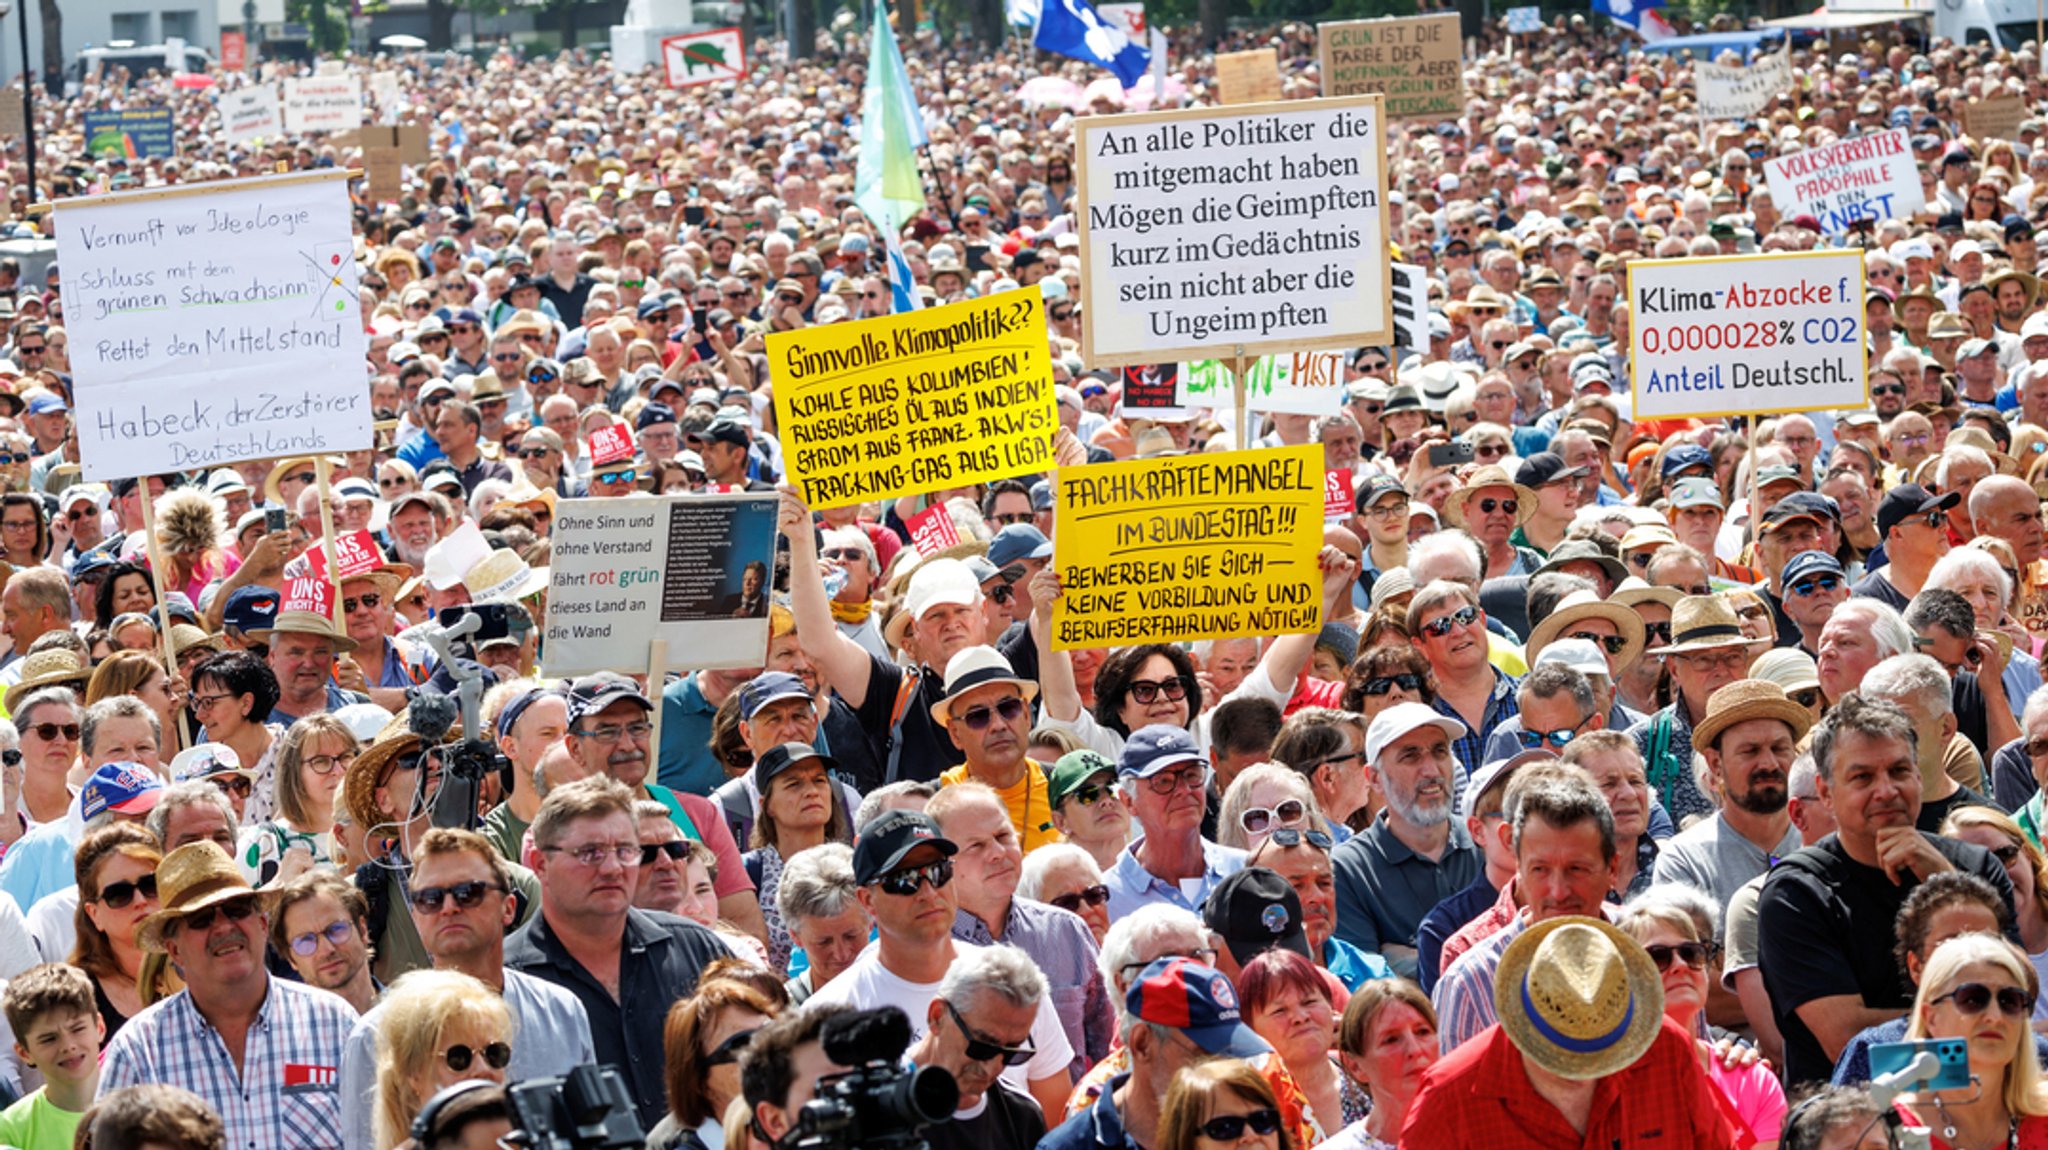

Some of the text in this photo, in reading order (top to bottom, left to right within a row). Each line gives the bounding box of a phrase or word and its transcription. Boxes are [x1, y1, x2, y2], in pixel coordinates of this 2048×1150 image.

[1379, 27, 1406, 43] IST
[1416, 24, 1443, 42] DIE
[1332, 46, 1424, 64] FARBE DER
[1417, 61, 1457, 76] ABER
[1334, 82, 1386, 96] DIESES
[1438, 77, 1457, 91] IST
[1098, 112, 1368, 157] An alle Politiker die
[1114, 152, 1359, 193] mitgemacht haben
[1090, 185, 1378, 233] Mögen die Geimpften
[1810, 190, 1867, 214] IN DEN
[1819, 193, 1895, 235] KNAST
[80, 204, 311, 251] Vernunft vor Ideologie
[1111, 225, 1361, 268] kurz im Gedächtnis
[79, 264, 236, 290] Schluss mit dem
[1119, 264, 1355, 303] sein nicht aber die
[1640, 277, 1851, 314] Klima-Abzocke f.
[95, 278, 308, 320] grünen Schwachsinn
[786, 299, 1033, 380] Sinnvolle Klimapolitik??
[1149, 302, 1329, 340] Ungeimpften
[1642, 317, 1858, 355] 0,000028% CO2
[96, 323, 341, 362] Rettet den Mittelstand
[1647, 357, 1854, 393] Anteil Deutschl.
[97, 391, 360, 440] Habeck, der Zerstörer
[789, 386, 853, 420] KOHLE
[860, 377, 899, 407] AUS
[789, 377, 1048, 444] RUSSISCHES ÖL AUS INDIEN!
[169, 428, 327, 467] Deutschlands
[592, 427, 619, 449] UNS
[796, 405, 1051, 475] STROM AUS FRANZ. AKW'S!
[801, 454, 952, 506] FRACKING-GAS
[956, 445, 999, 474] AUS
[1063, 458, 1313, 509] FACHKRÄFTEMANGEL
[558, 516, 594, 530] Ohne
[597, 515, 625, 530] Sinn
[629, 514, 655, 528] und
[1116, 505, 1297, 546] IM BUNDESTAG!!!
[555, 541, 590, 556] ohne
[593, 540, 652, 555] Verstand
[553, 571, 586, 587] fährt
[588, 568, 615, 585] rot
[618, 566, 660, 588] grün
[1064, 561, 1175, 590] BEWERBEN
[1182, 554, 1212, 580] SIE
[1219, 550, 1264, 577] SICH
[290, 577, 325, 603] UNS
[550, 600, 592, 615] dieses
[595, 598, 627, 613] Land
[629, 600, 646, 612] an
[1065, 582, 1312, 616] KEINE VORBILDUNG UND
[547, 623, 612, 640] die Wand
[1058, 605, 1318, 643] BERUFSERFAHRUNG NÖTIG!!!
